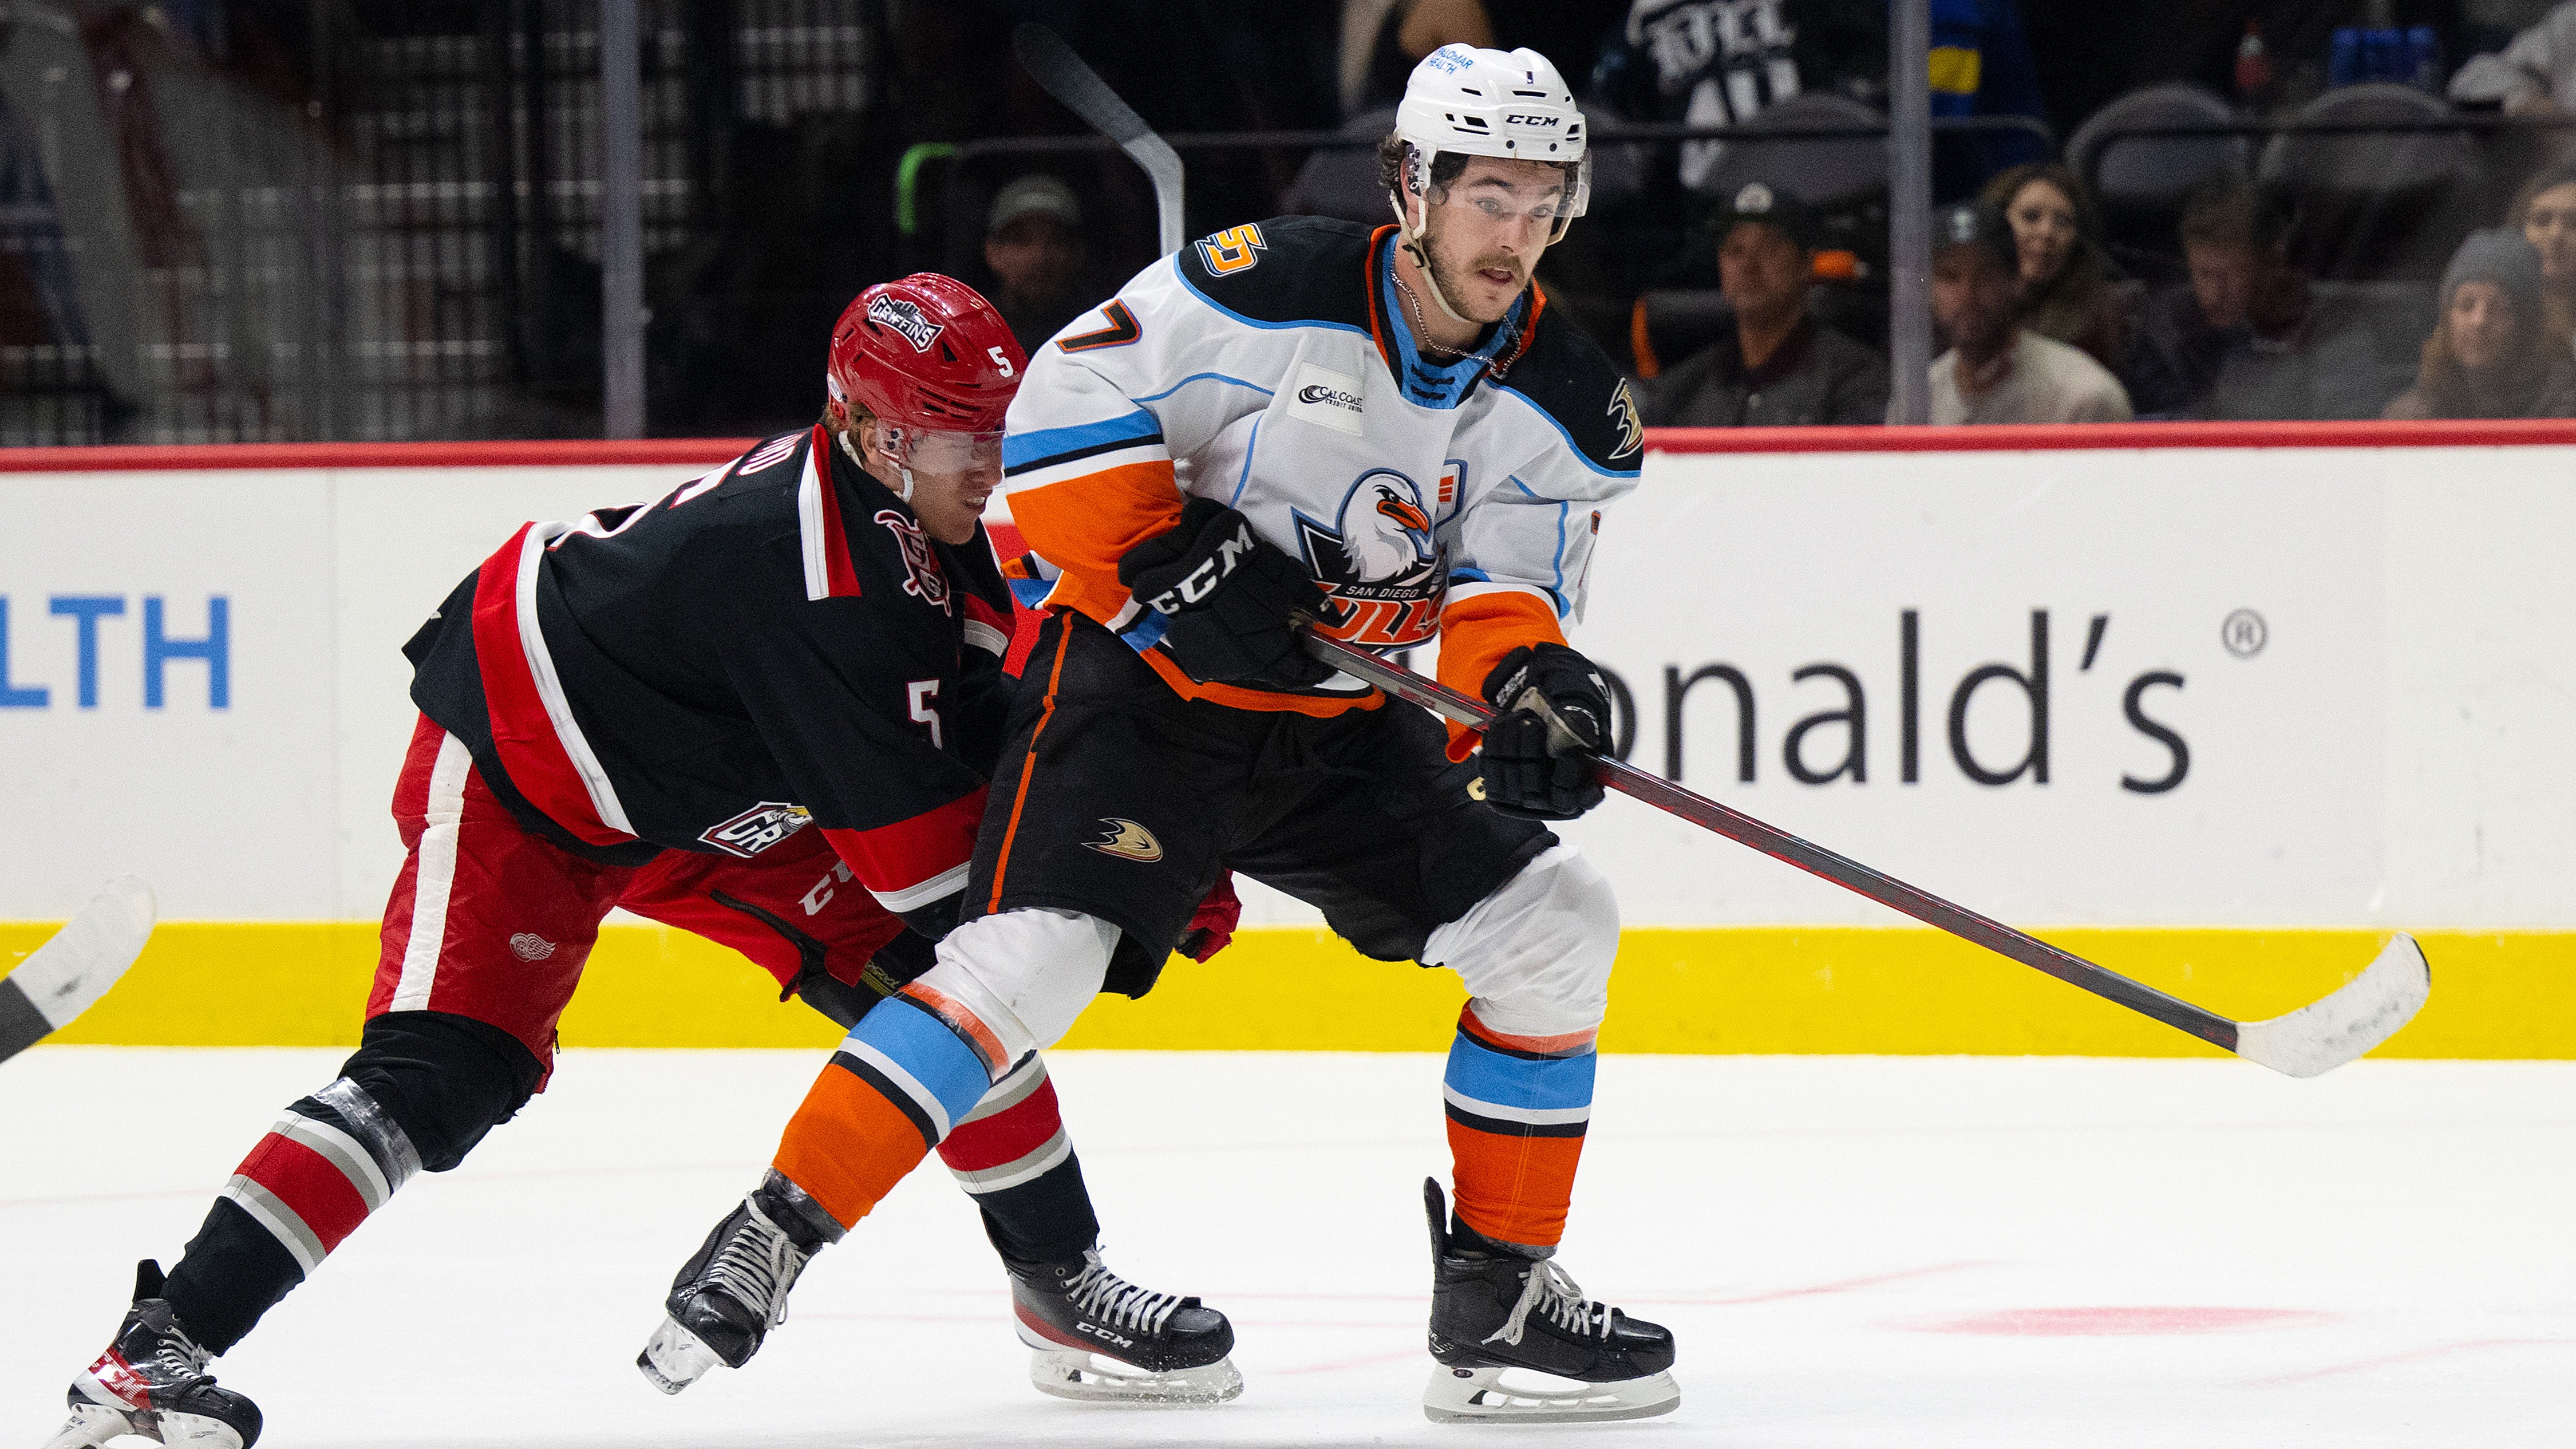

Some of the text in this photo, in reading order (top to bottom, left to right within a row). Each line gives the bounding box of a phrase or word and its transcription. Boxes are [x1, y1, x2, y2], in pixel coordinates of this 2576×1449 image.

[1428, 57, 1457, 76] HEALTH
[1437, 48, 1474, 69] PALOMAR
[1506, 114, 1560, 127] CCM
[870, 295, 937, 348] GRIFFINS
[1054, 297, 1143, 355] 7
[987, 346, 1014, 378] 5
[1320, 386, 1363, 407] CAL COAST
[1325, 398, 1346, 409] CREDIT
[1146, 522, 1255, 615] CCM
[1346, 585, 1419, 598] SAN DIEGO
[906, 678, 943, 751] 5
[714, 809, 784, 853] GR
[1076, 1320, 1133, 1348] CCM
